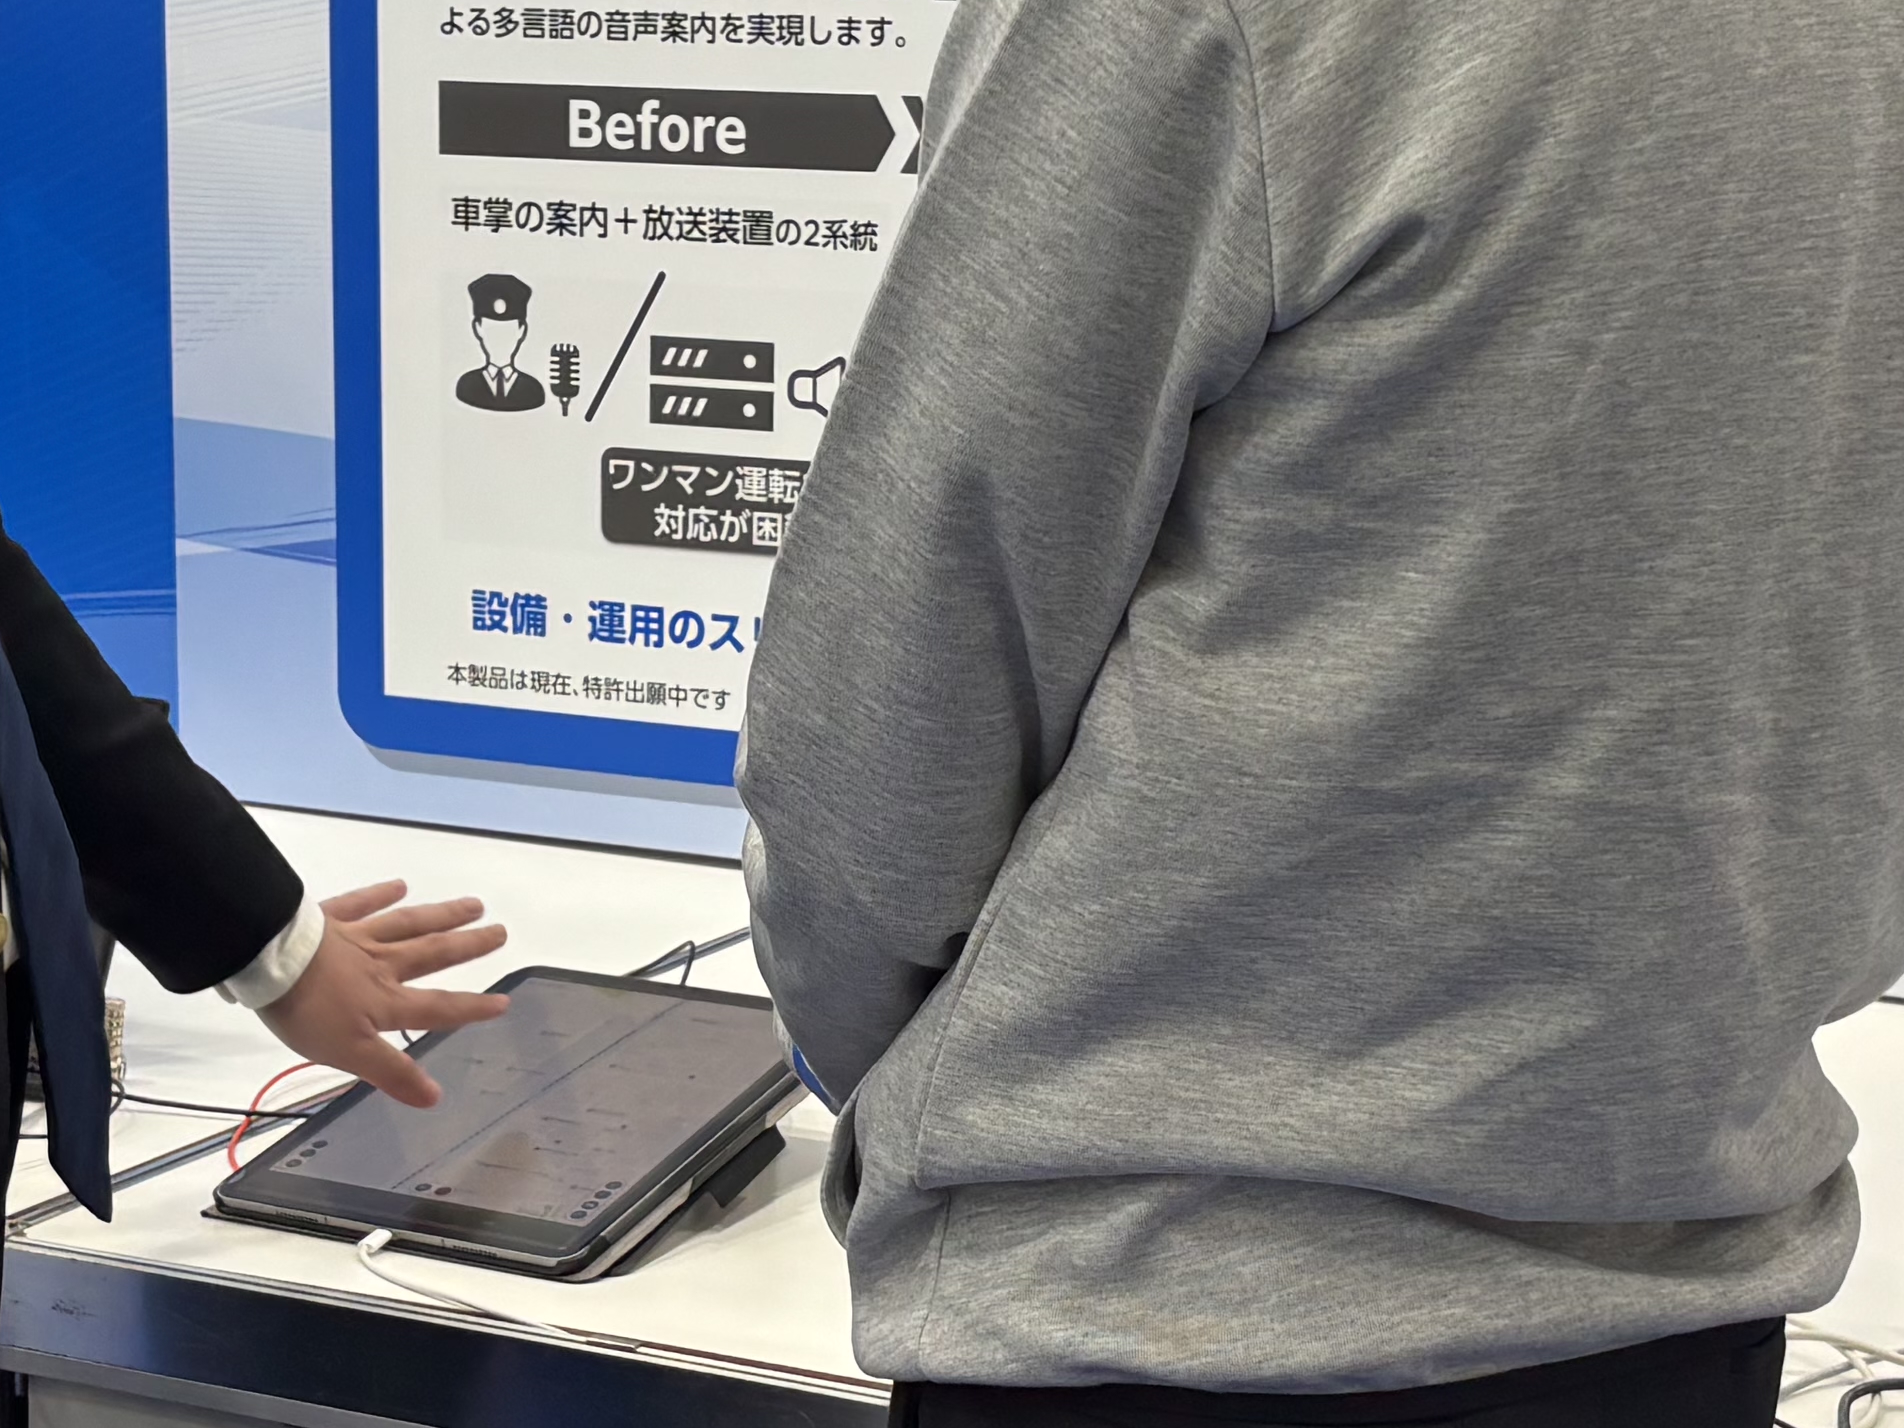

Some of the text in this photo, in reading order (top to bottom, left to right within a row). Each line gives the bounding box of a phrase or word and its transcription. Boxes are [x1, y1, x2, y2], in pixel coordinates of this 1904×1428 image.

[438, 6, 908, 50] よる多言語の音声案内を実現します。
[567, 98, 747, 155] Before
[607, 458, 811, 504] ワンマン運転
[653, 503, 795, 548] 対応が困
[446, 662, 733, 712] 本製品は現在、特許出願中です
